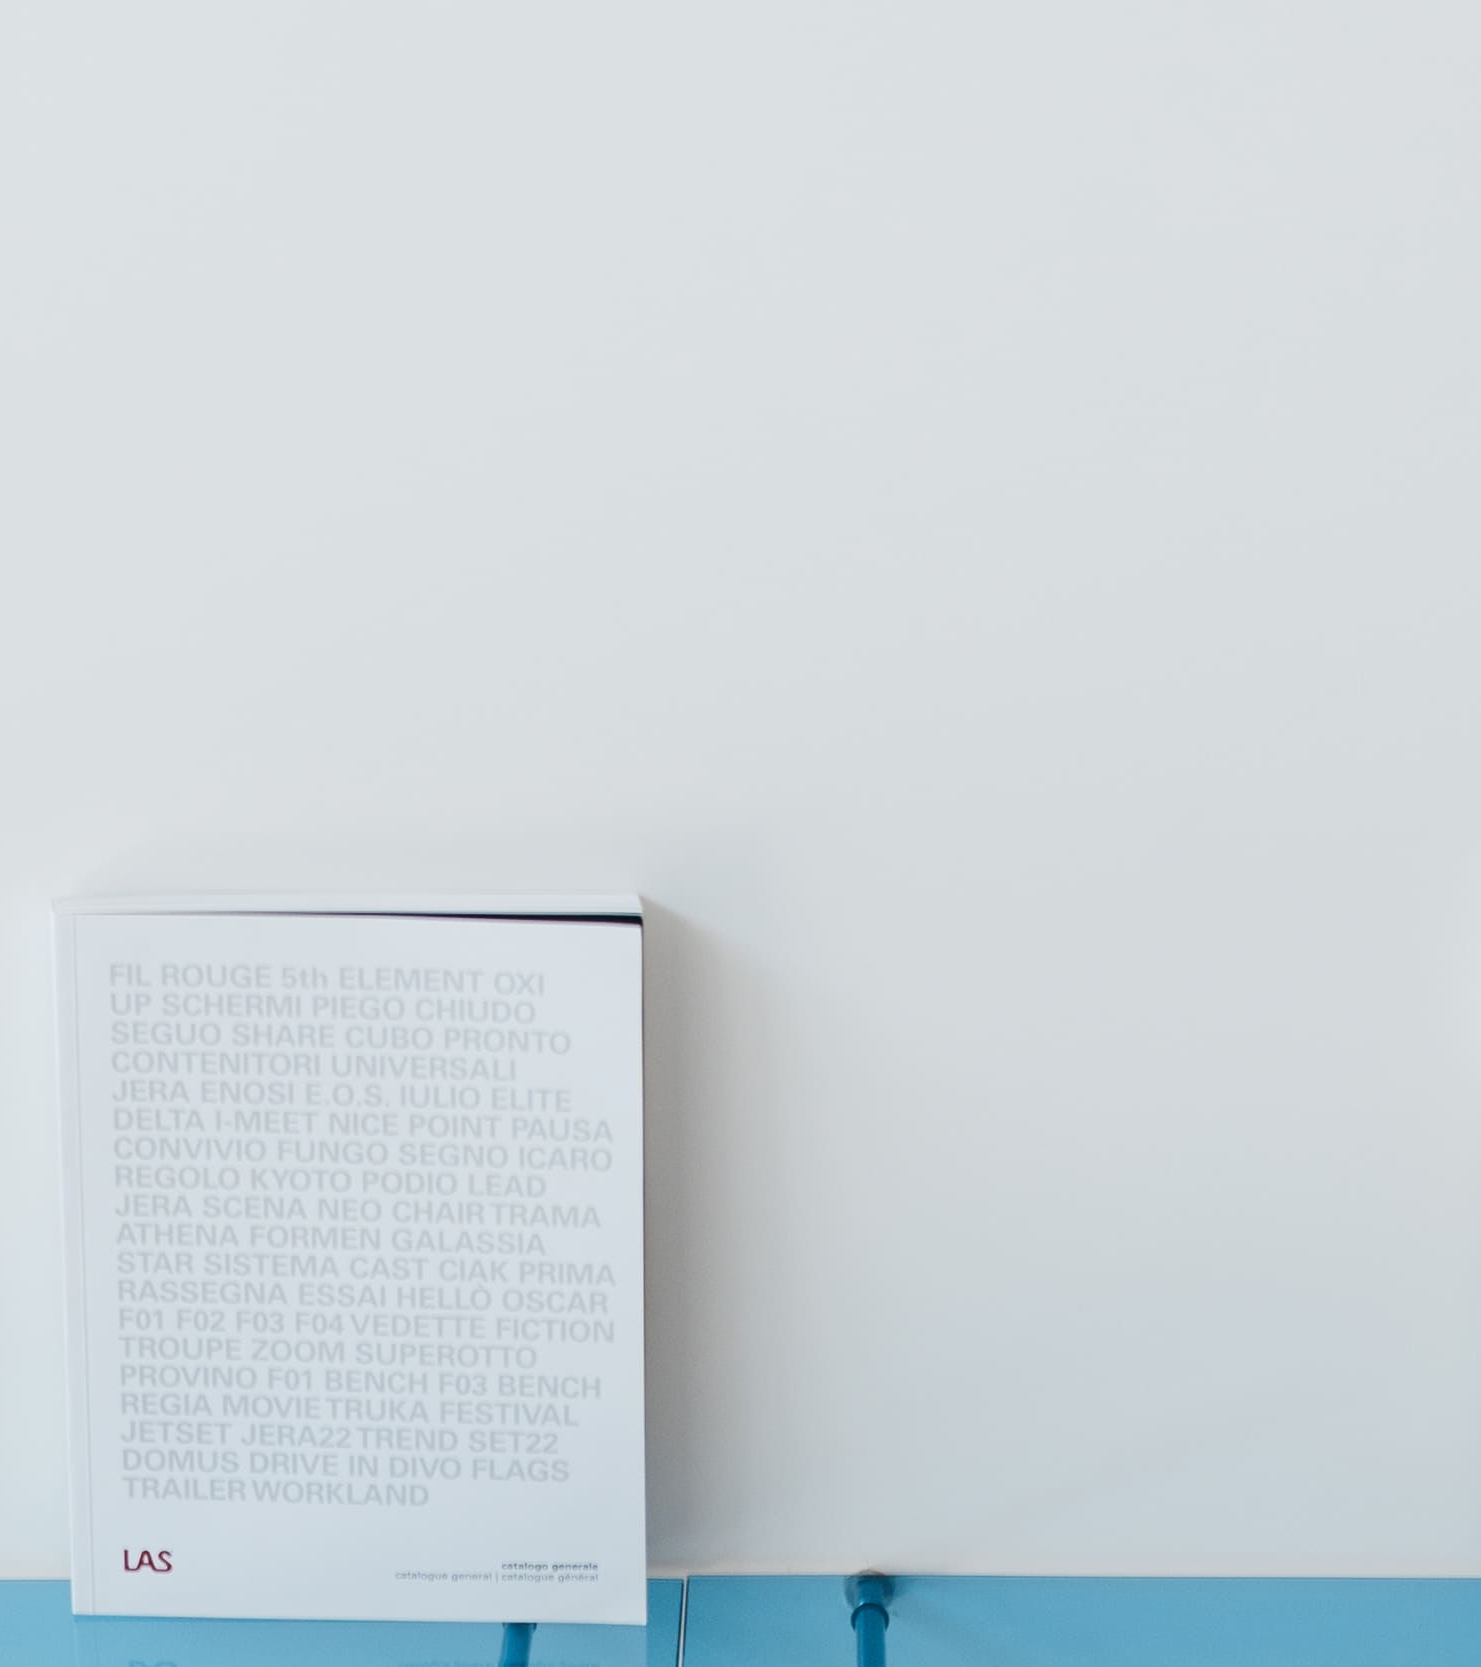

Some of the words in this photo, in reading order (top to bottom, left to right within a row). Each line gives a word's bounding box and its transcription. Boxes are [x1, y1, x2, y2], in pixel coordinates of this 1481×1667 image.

[110, 963, 151, 985] FIL
[161, 962, 271, 988] ROUGE
[282, 967, 328, 989] 5th
[339, 966, 483, 992] ELEMENT
[494, 971, 544, 995] OXI
[110, 991, 152, 1015] UP
[162, 992, 302, 1018] SCHERMI
[312, 995, 405, 1020] PIEGO
[415, 997, 536, 1023] CHIUDO
[111, 1020, 222, 1045] SEGUO
[232, 1022, 334, 1047] SHARE
[345, 1025, 434, 1049] CUBO
[444, 1028, 571, 1053] PRONTO
[111, 1048, 320, 1077] CONTENITORI
[331, 1053, 516, 1081] UNIVERSALI
[113, 1107, 206, 1132] DELTA
[215, 1109, 319, 1134] I-MEET
[329, 1111, 398, 1136] NICE
[409, 1113, 502, 1138] POINT
[512, 1117, 613, 1141] PAUSA
[115, 1164, 240, 1191] REGOLO
[250, 1166, 352, 1192] KYOTO
[362, 1170, 458, 1195] PODIO
[468, 1173, 547, 1197] LEAD
[117, 1249, 194, 1275] STAR
[203, 1252, 340, 1277] SISTEMA
[350, 1256, 430, 1280] CAST
[438, 1258, 509, 1283] CIAK
[519, 1261, 616, 1286] PRIMA
[119, 1306, 163, 1330] F01
[177, 1309, 226, 1331] F02
[236, 1311, 285, 1334] F03
[295, 1311, 345, 1335] F04
[350, 1313, 486, 1338] VEDETTE
[496, 1316, 614, 1343] FICTION
[120, 1364, 257, 1388] PROVINO
[268, 1367, 312, 1390] F01
[325, 1368, 428, 1394] BENCH
[438, 1372, 488, 1394] F03
[498, 1375, 601, 1398] BENCH
[122, 1475, 246, 1500] TRAILER
[251, 1479, 429, 1506] WORKLAND
[123, 1549, 173, 1573] LAS
[502, 1562, 548, 1570] catalogo
[552, 1563, 598, 1571] generale
[502, 1573, 554, 1582] catalogue
